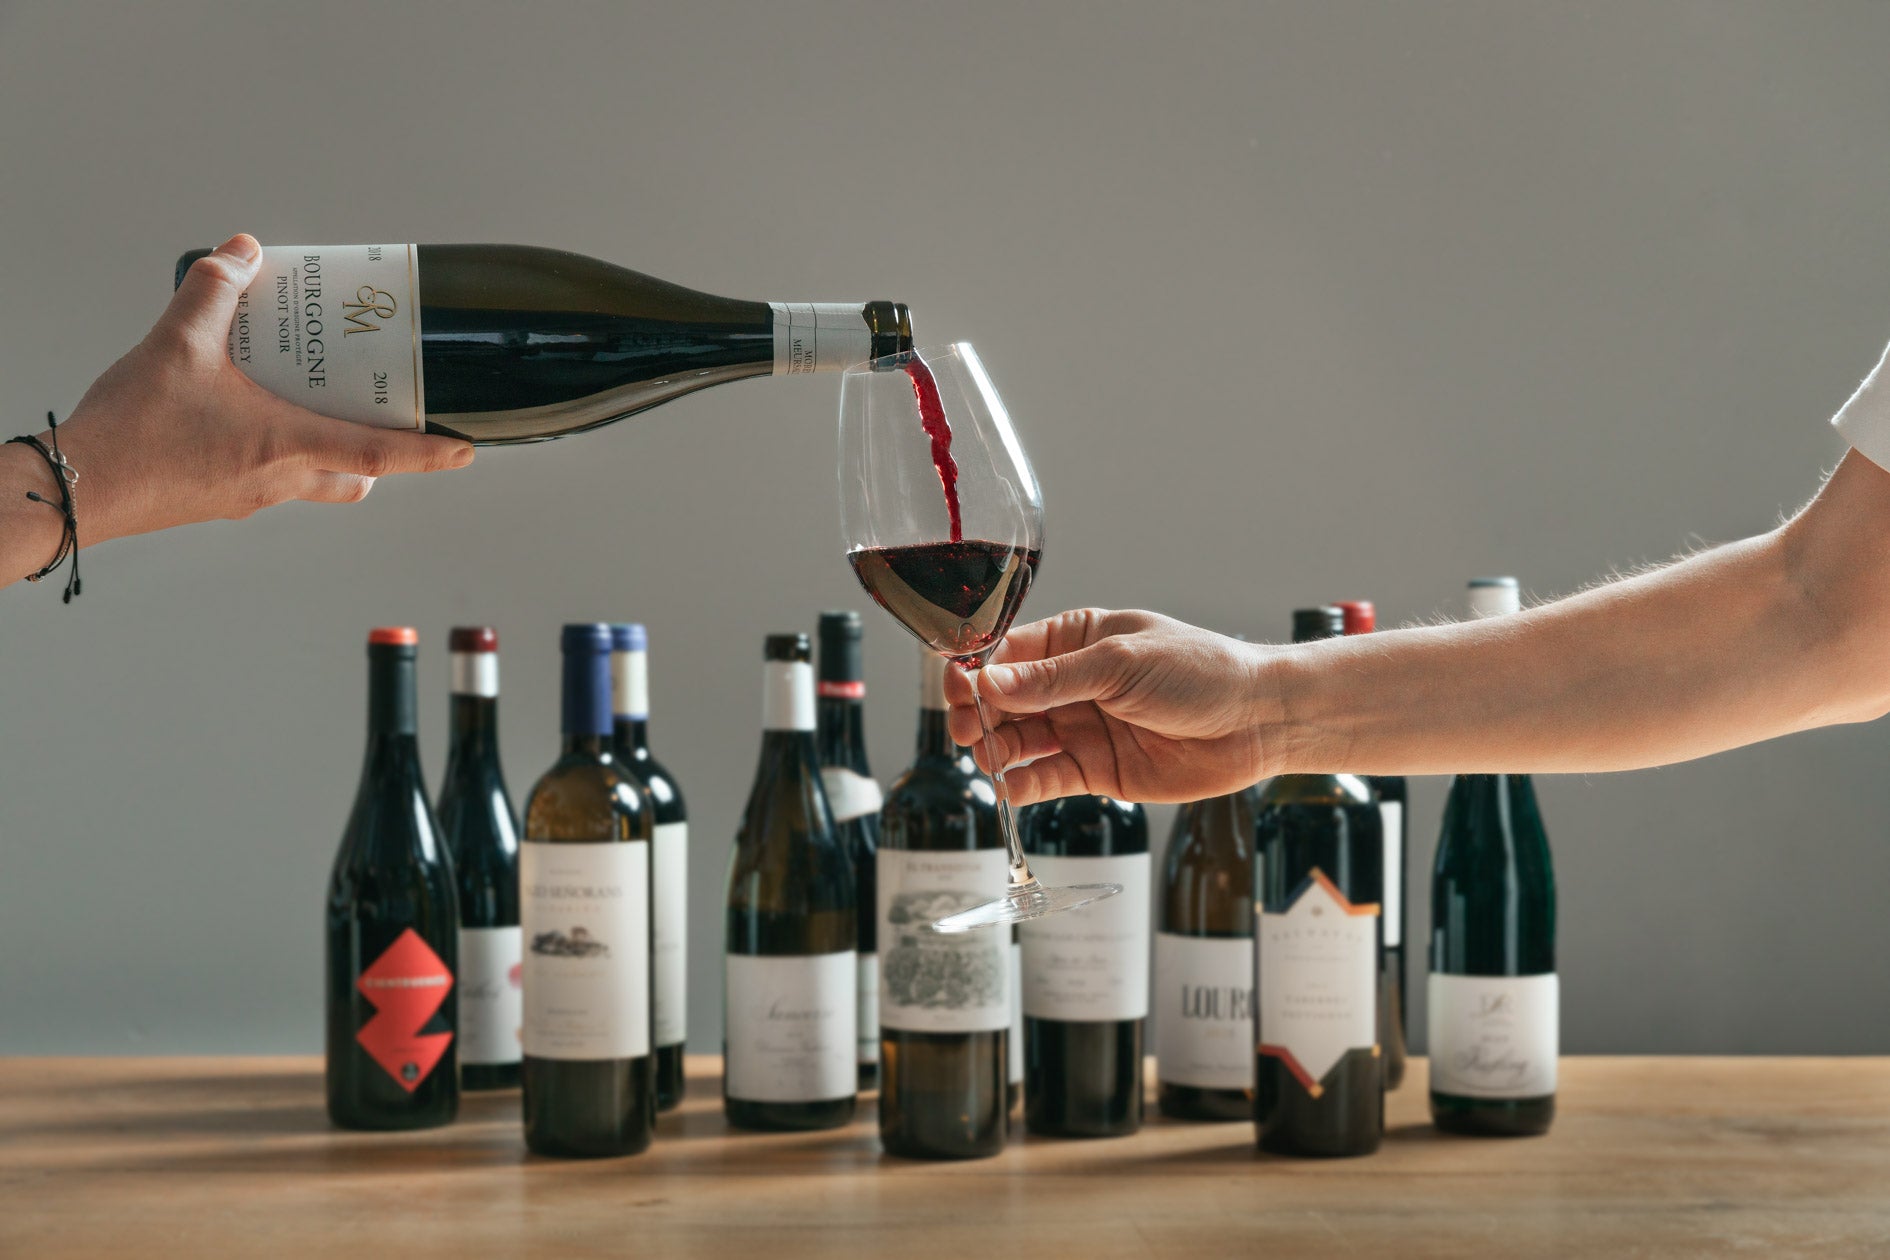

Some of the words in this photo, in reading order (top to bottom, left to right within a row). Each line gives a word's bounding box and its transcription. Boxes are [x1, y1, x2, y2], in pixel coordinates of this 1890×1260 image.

[367, 246, 382, 262] 2018
[238, 289, 248, 309] RE
[276, 276, 289, 313] PINOT
[239, 312, 252, 364] MOREY
[278, 317, 290, 354] NOIR
[303, 255, 325, 388] BOURGOGNE
[802, 351, 812, 373] MORE
[373, 371, 388, 404] 2018
